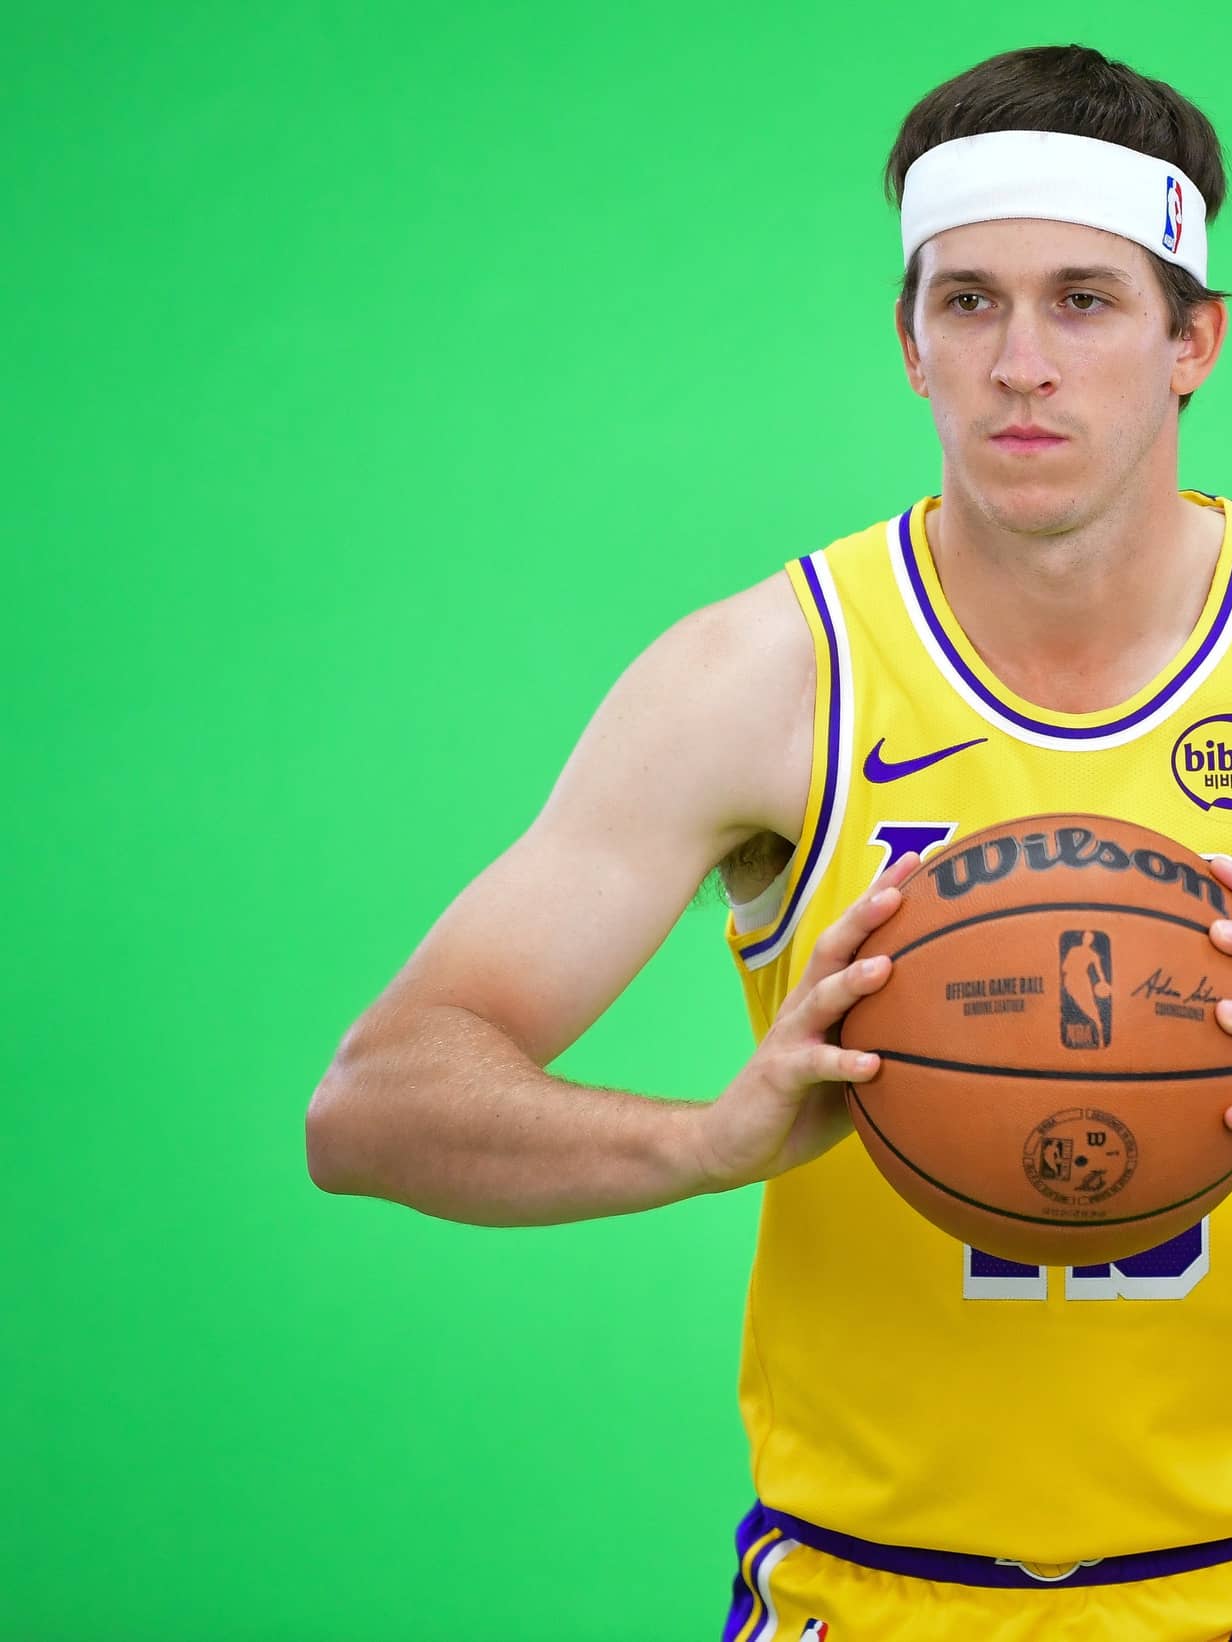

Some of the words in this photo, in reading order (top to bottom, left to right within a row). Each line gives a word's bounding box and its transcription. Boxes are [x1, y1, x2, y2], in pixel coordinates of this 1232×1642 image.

[928, 827, 1229, 919] Wilson
[945, 979, 986, 1000] OFFICIAL
[989, 976, 1017, 996] GAME
[1019, 975, 1045, 994] BALL
